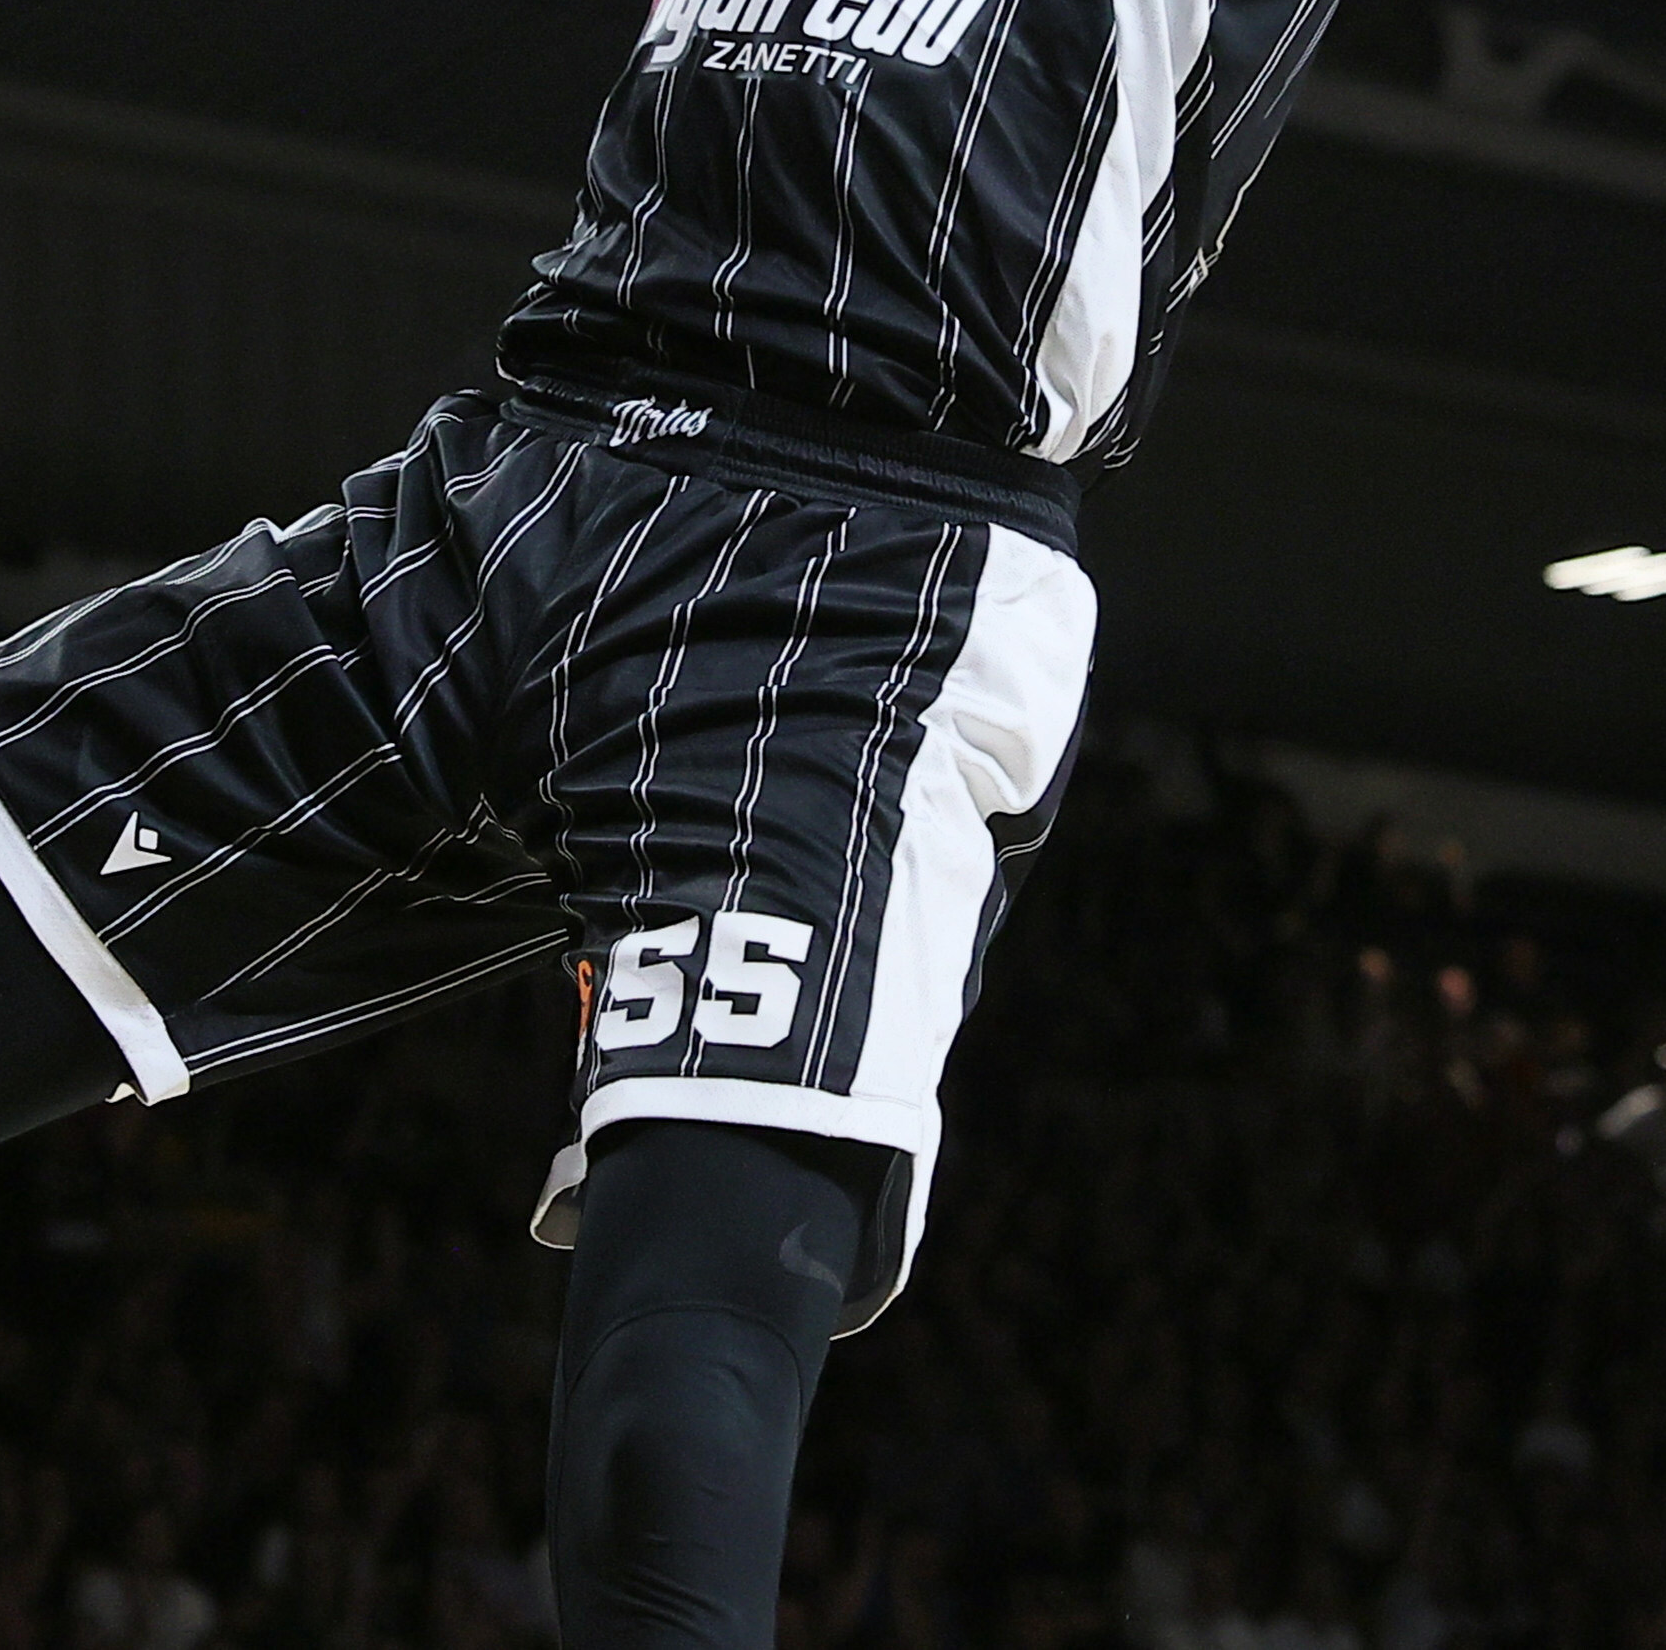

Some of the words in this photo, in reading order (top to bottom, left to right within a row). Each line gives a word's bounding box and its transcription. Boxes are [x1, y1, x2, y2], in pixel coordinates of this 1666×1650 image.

[702, 40, 868, 85] ZANETTI
[609, 395, 713, 448] Virtus
[594, 910, 815, 1051] 55
